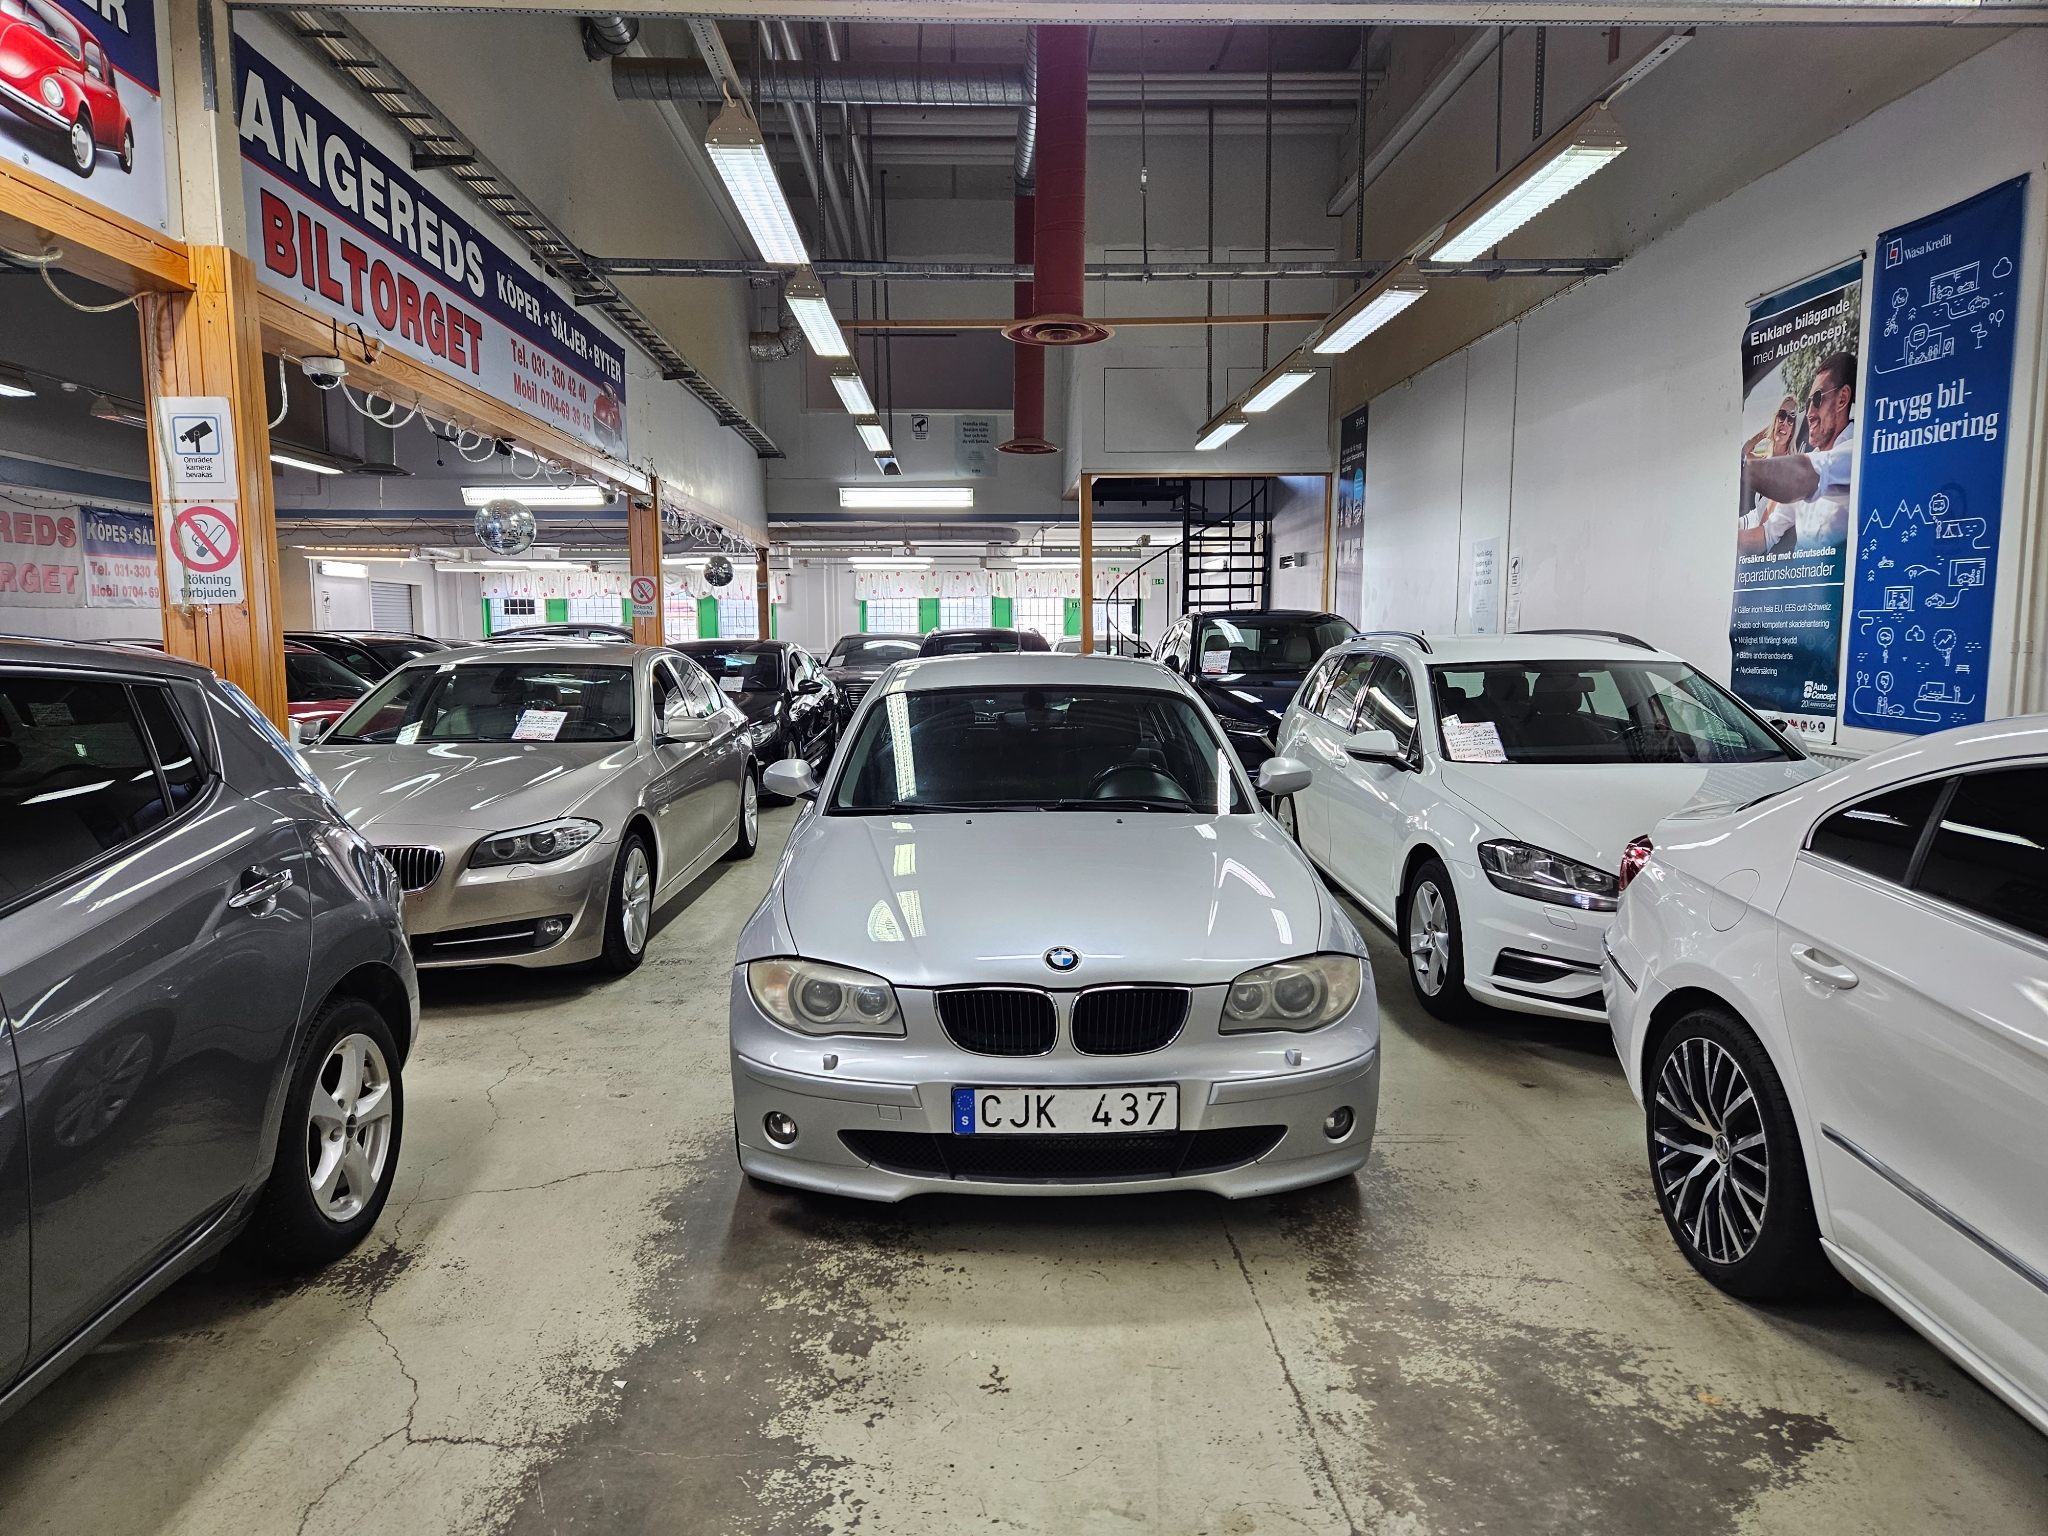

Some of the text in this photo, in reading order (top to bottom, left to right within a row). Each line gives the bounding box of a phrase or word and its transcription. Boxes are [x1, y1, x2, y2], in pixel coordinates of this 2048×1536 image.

[239, 69, 485, 298] ANGEREDS
[1904, 233, 1952, 261] Wasa Kredit
[260, 187, 482, 376] BILTORGET
[497, 270, 621, 383] KÖPER SÄLJER BYTER
[1750, 299, 1850, 346] Enklare bilägande
[1753, 320, 1848, 366] med AutoConcept
[511, 338, 529, 370] Tel.
[551, 365, 565, 391] 330
[567, 375, 577, 397] 42
[578, 382, 587, 404] 40
[513, 373, 591, 432] Mobil 0704-69 39 35
[1875, 377, 1973, 424] Trygg bil-
[1871, 412, 1999, 454] finansiering
[183, 456, 213, 464] Området
[186, 463, 213, 471] kamera-
[1738, 546, 1836, 565] Försäkra dig mot oförutsedda
[90, 561, 111, 576] Tel.
[114, 562, 151, 578] 031-330
[1737, 561, 1835, 585] reparationskostnader
[91, 583, 119, 597] Mobil
[1784, 603, 1796, 612] EES
[1797, 603, 1807, 611] och
[1807, 602, 1832, 611] Schweiz
[1752, 620, 1761, 629] och
[1811, 690, 1837, 701] Concept
[1813, 682, 1828, 691] Auto
[1801, 700, 1808, 708] 20
[961, 1116, 969, 1125] S
[981, 1092, 1167, 1128] CJK 437
